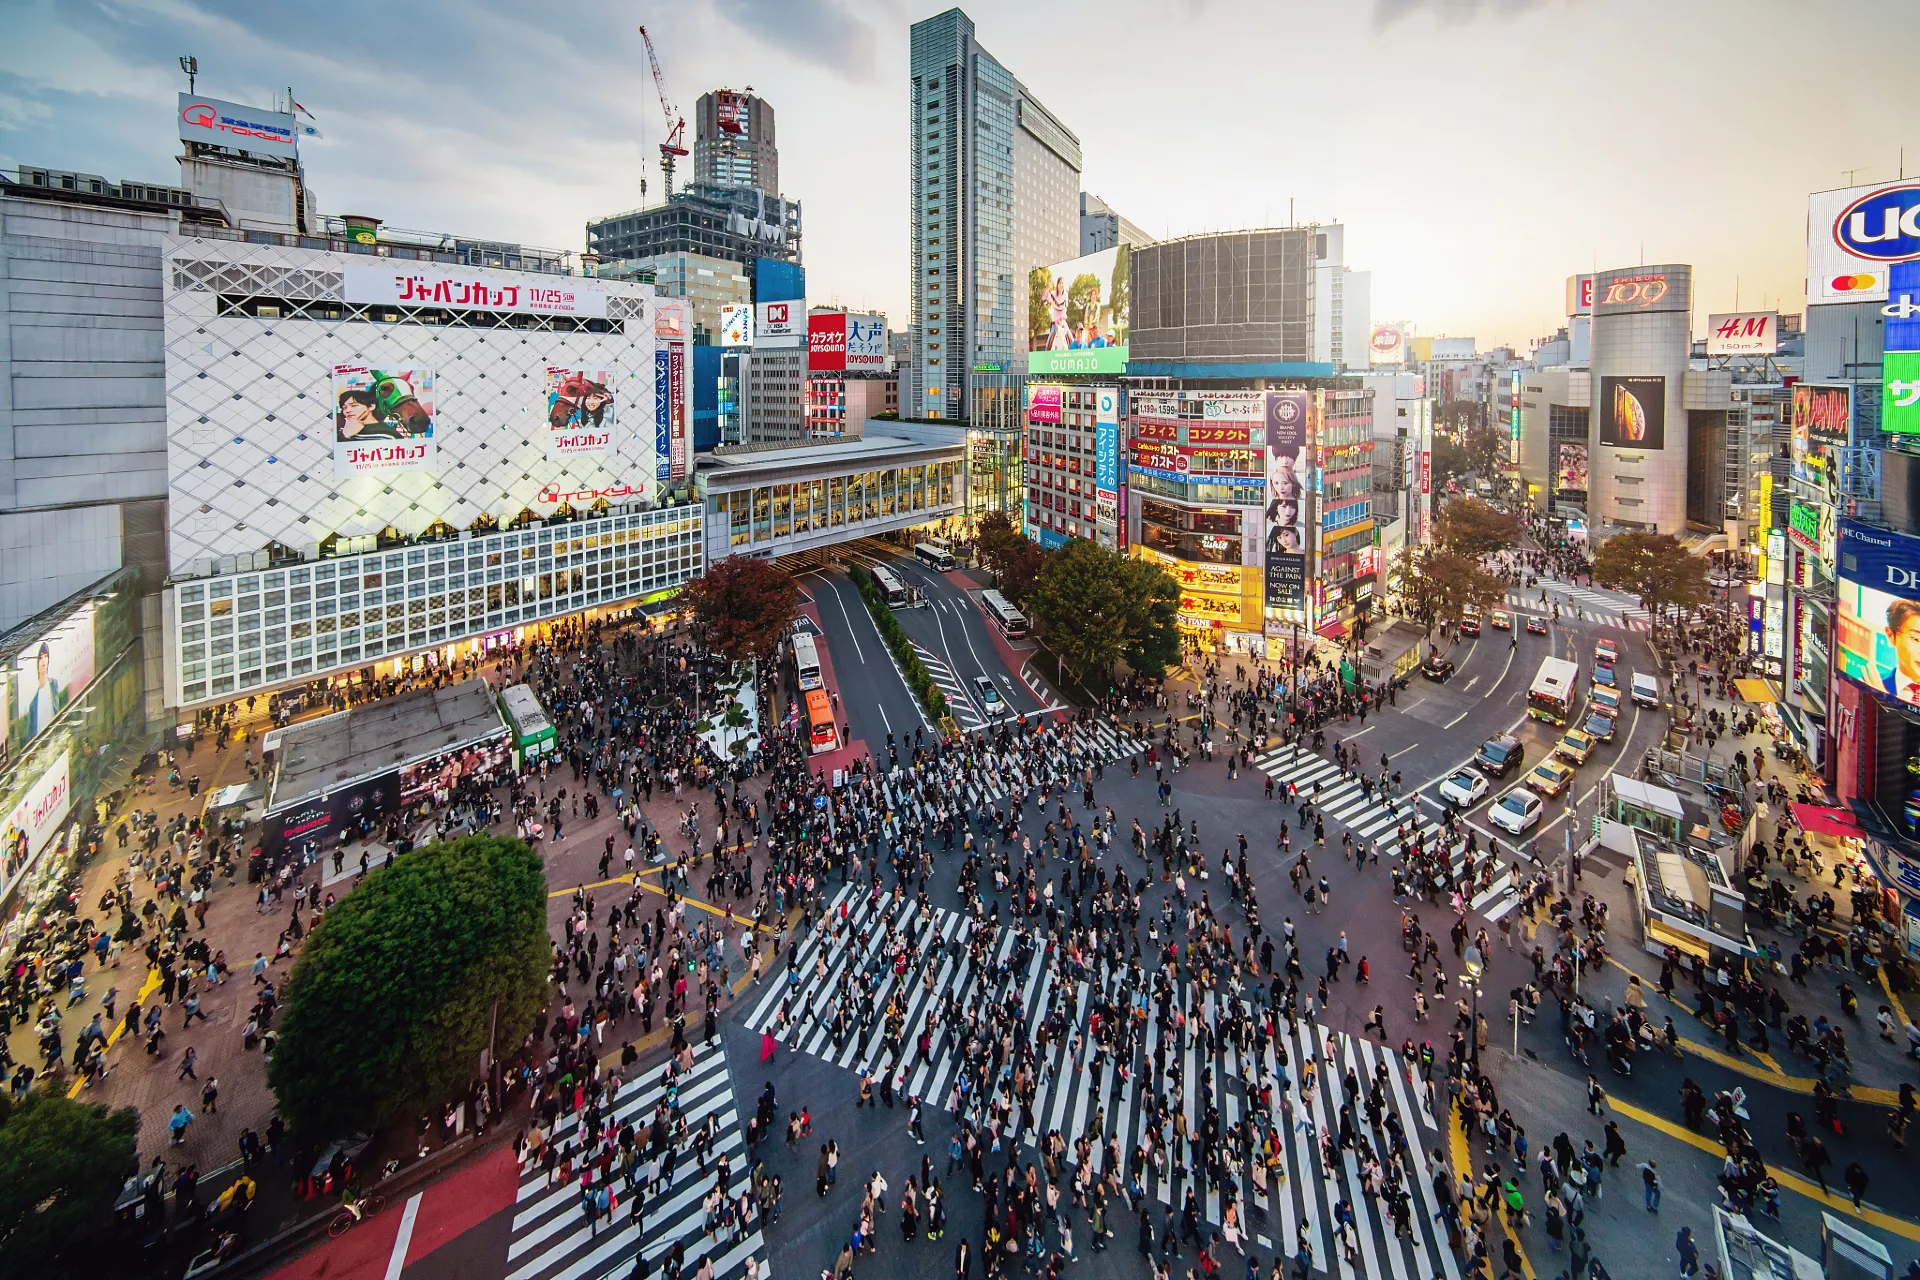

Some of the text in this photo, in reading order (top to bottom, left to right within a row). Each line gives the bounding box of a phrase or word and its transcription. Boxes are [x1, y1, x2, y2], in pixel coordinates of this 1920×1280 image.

[214, 123, 293, 144] TOKYU
[1613, 275, 1665, 284] SHIBUYA
[395, 276, 521, 307] ジャパンカップ
[529, 288, 561, 303] 11/25
[1602, 280, 1668, 308] 109
[847, 320, 883, 342] 大声
[1716, 316, 1768, 339] H&M
[810, 331, 844, 344] カラオケ
[810, 343, 845, 353] JOYSOUND
[846, 354, 884, 364] JOYSOUND
[1060, 357, 1098, 371] UMAJO
[1139, 424, 1177, 438] プライス
[1189, 428, 1248, 441] コンタクト
[555, 432, 610, 448] ジャパンカップ
[346, 444, 427, 464] ジャパンカップ
[1098, 428, 1107, 485] アイシティ
[1108, 429, 1116, 486] コンタクトの
[1160, 444, 1180, 456] ガスト
[1229, 450, 1257, 460] ガスト
[1150, 454, 1175, 469] ガスト
[1211, 477, 1264, 486] 英会話イーオン
[558, 484, 644, 502] TOKYU
[1841, 527, 1892, 547] DHC Channel
[1269, 571, 1284, 579] THE
[1270, 565, 1301, 574] AGAINST
[1356, 582, 1373, 599] LUSH
[283, 815, 332, 838] G-SHOCK
